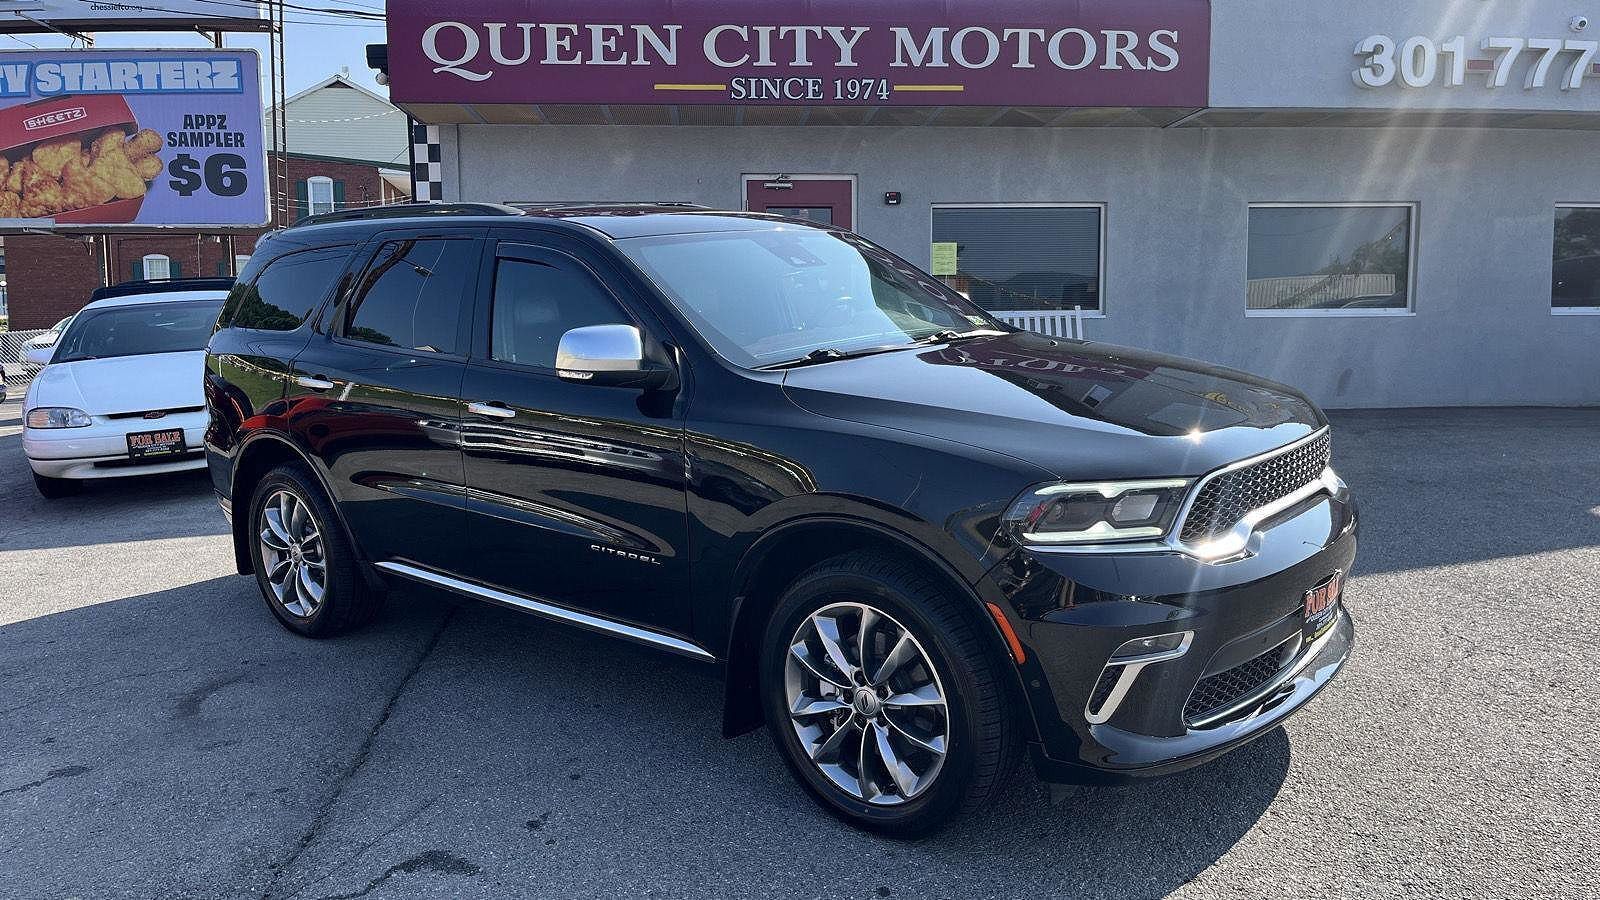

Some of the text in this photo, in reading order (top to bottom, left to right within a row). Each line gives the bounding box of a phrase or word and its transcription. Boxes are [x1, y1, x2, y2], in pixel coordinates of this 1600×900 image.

[421, 21, 1180, 82] QUEEN CITY MOTORS
[1352, 34, 1600, 91] 301-777
[36, 61, 239, 93] STARTERZ
[730, 76, 890, 101] SINCE 1974
[27, 109, 83, 128] SHEETZ
[183, 114, 228, 130] APPZ
[167, 131, 245, 148] SAMPLER
[168, 153, 248, 197] $6
[130, 434, 152, 446] FOR
[154, 431, 180, 444] SALE
[590, 544, 661, 565] CITADEL
